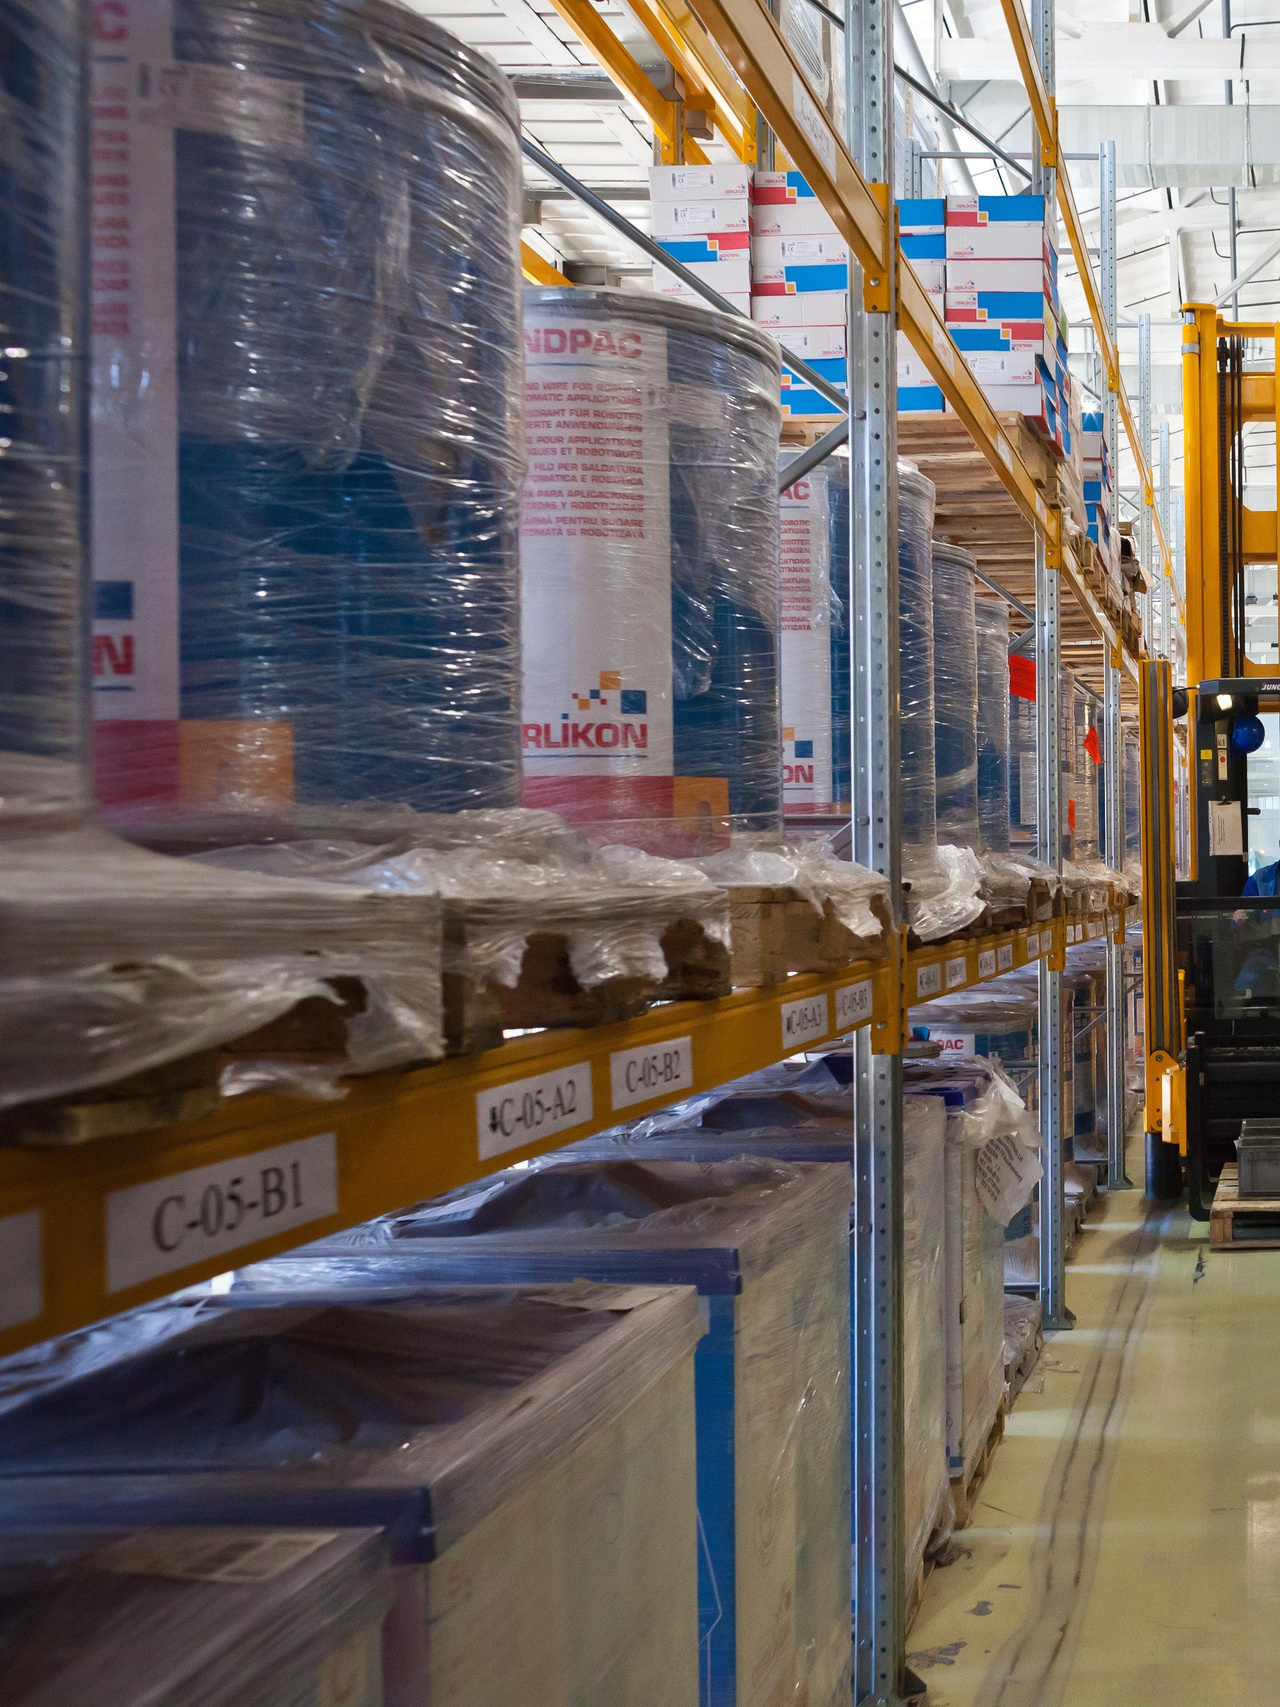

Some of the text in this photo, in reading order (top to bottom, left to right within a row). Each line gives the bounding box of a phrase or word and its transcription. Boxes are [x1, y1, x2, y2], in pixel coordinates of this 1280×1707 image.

[572, 382, 593, 391] FOR
[566, 394, 643, 406] APPLICATIONS
[537, 436, 564, 444] POUR
[567, 436, 643, 448] APPLICATIONS
[560, 448, 572, 456] ET
[575, 448, 643, 460] ROBOTIQUES
[534, 463, 644, 475] FILO PER SALDATURA
[591, 475, 644, 486] ROBOTICA
[537, 490, 564, 498] PARA
[555, 517, 598, 525] PENTRU
[791, 1004, 822, 1034] C-05-A3
[625, 1050, 681, 1093] C-05-B2
[500, 1079, 577, 1137] C-05-A2
[153, 1161, 304, 1252] C-05-B1
